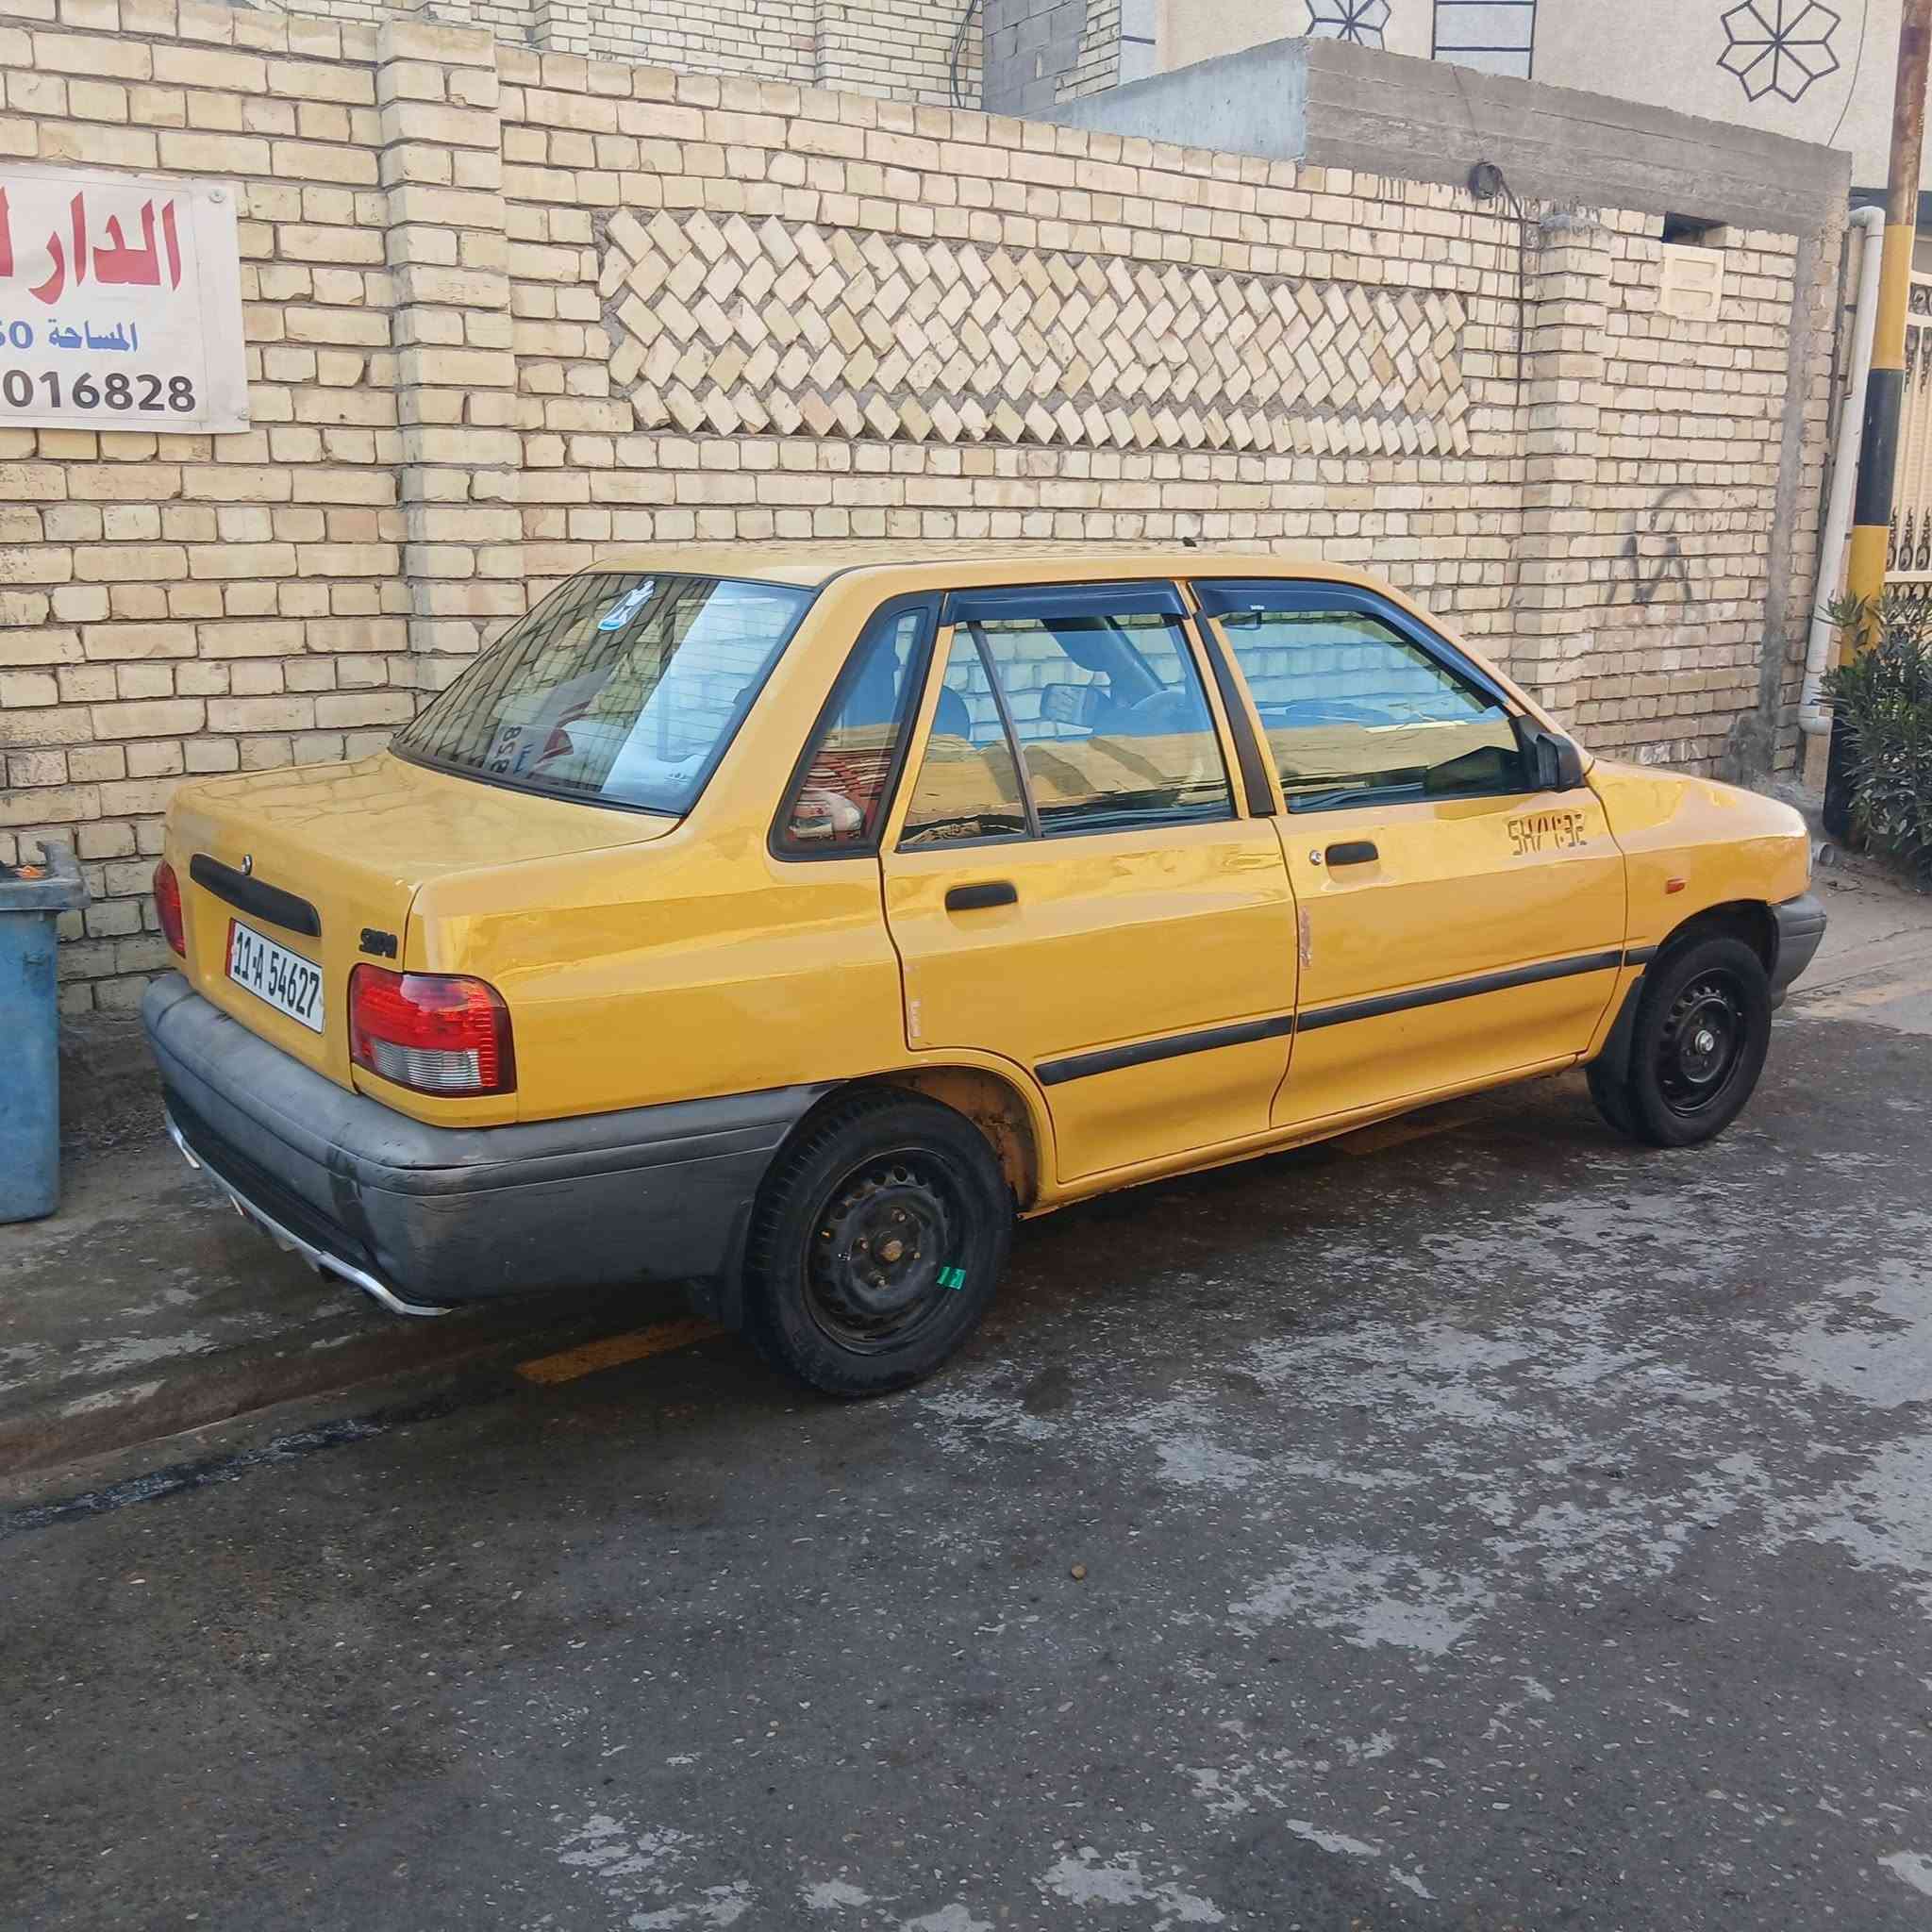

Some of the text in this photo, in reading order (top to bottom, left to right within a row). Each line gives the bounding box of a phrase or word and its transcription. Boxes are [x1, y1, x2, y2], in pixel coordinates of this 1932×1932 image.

[27, 190, 182, 305] الدار
[47, 318, 140, 353] المساحة
[2, 369, 196, 412] 016828
[234, 931, 321, 1019] 11-A 54627
